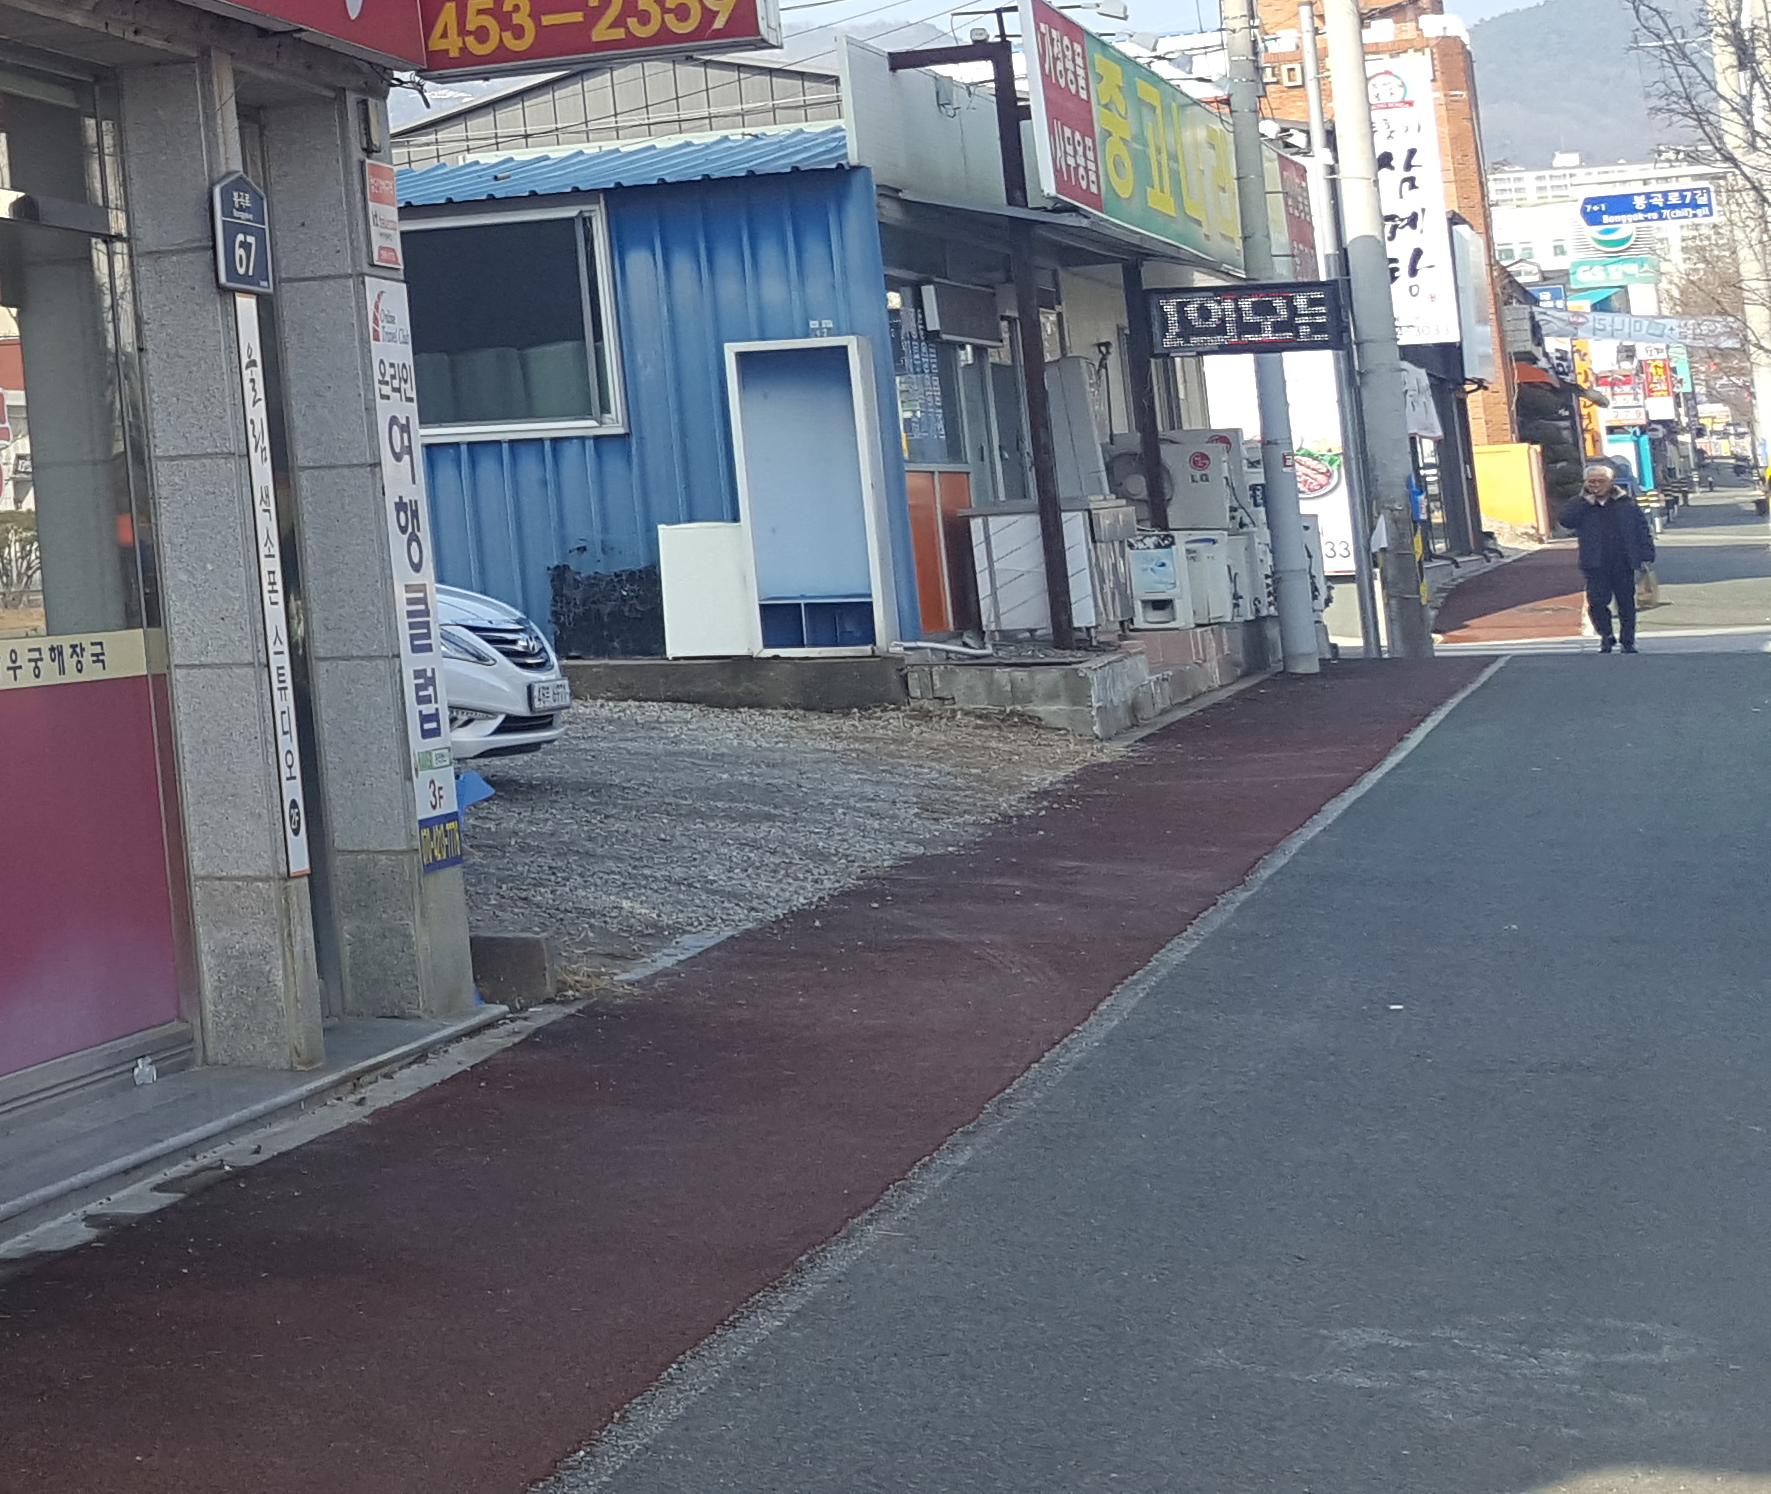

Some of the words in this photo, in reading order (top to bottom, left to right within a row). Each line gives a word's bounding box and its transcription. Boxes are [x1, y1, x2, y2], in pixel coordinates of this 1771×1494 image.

[1037, 21, 1089, 101] 가정용품
[1093, 52, 1241, 251] 중고나라
[1632, 189, 1709, 211] 봉곡로7길
[234, 232, 257, 277] 67
[377, 358, 416, 405] 온라인
[1190, 472, 1210, 484] LG
[260, 484, 280, 606] 색소폰
[272, 624, 298, 782] 스튜디오
[428, 777, 444, 811] 3F
